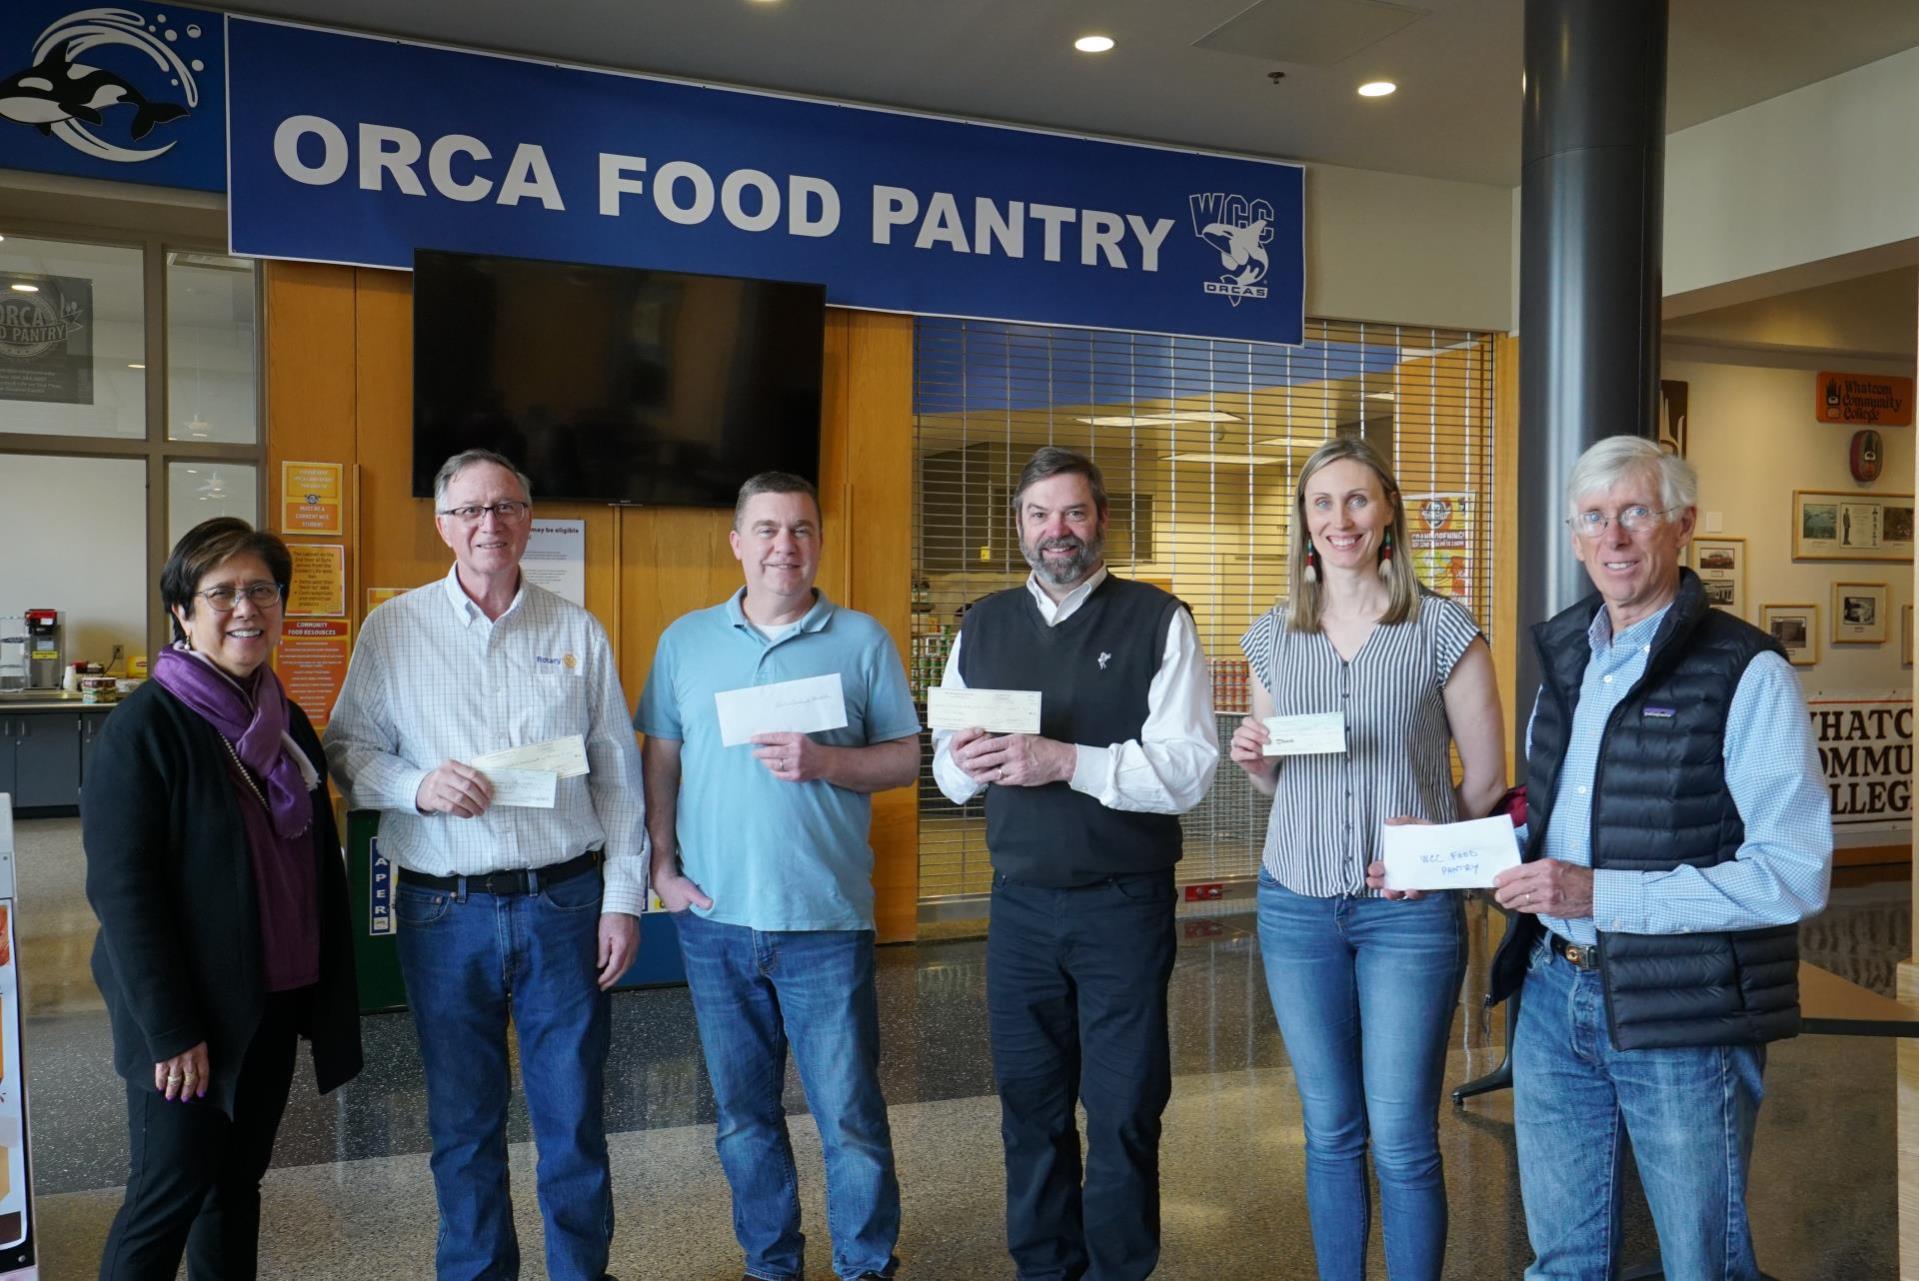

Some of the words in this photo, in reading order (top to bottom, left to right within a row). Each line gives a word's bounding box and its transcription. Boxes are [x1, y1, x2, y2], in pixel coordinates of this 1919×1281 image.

[273, 114, 566, 211] ORCA
[598, 152, 841, 239] FOOD
[872, 184, 1176, 272] PANTRY
[1189, 193, 1274, 243] WCC
[1206, 284, 1266, 297] ORCAS
[12, 325, 66, 343] PANTRY
[1843, 380, 1892, 395] Whatcom
[1842, 394, 1902, 412] Community
[555, 527, 579, 535] eligible
[1829, 780, 1912, 815] LLEG
[375, 857, 388, 914] APER
